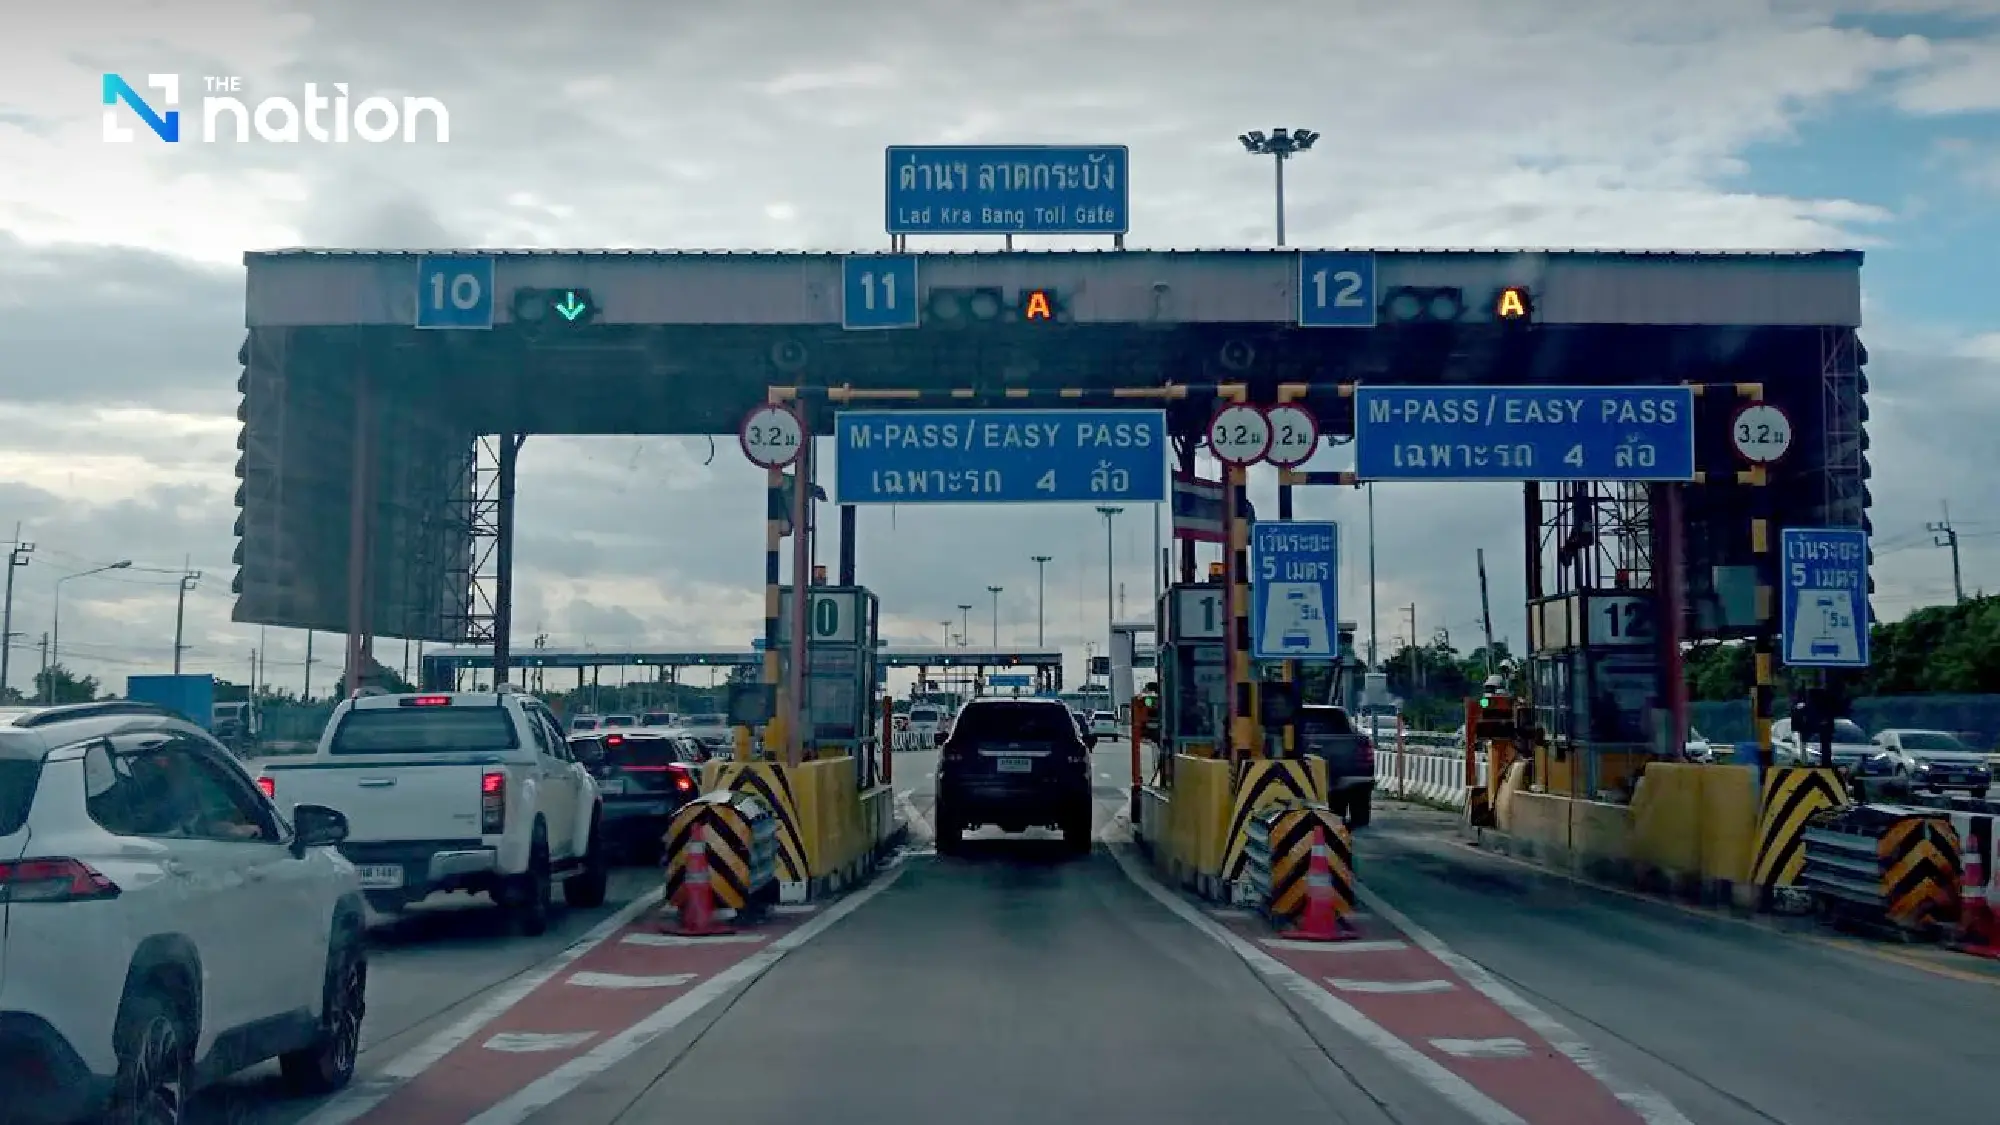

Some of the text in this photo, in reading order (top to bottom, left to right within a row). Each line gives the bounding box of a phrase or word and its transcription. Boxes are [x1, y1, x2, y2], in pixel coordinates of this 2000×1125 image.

[979, 153, 1115, 190] ลาดกระบัง
[900, 206, 1114, 228] Lad Kra Bang Toll Gate
[431, 272, 480, 310] 10
[860, 271, 897, 310] 11
[1026, 291, 1052, 318] A
[1312, 271, 1366, 309] 12
[1500, 290, 1525, 317] A
[1369, 394, 1677, 426] M-PASS/EASY PASS
[850, 419, 1150, 450] M-PASS/EASY PASS
[1394, 432, 1655, 467] เฉพาะรถ 4 ล้อ
[872, 460, 1129, 493] เฉพาะรถ 4 ล้อ
[1260, 528, 1330, 552] เว้นระยะ
[1262, 556, 1329, 580] 5 เมตร
[1791, 562, 1859, 588] 5 เมตร
[1199, 596, 1222, 632] 1
[1603, 602, 1651, 637] 12
